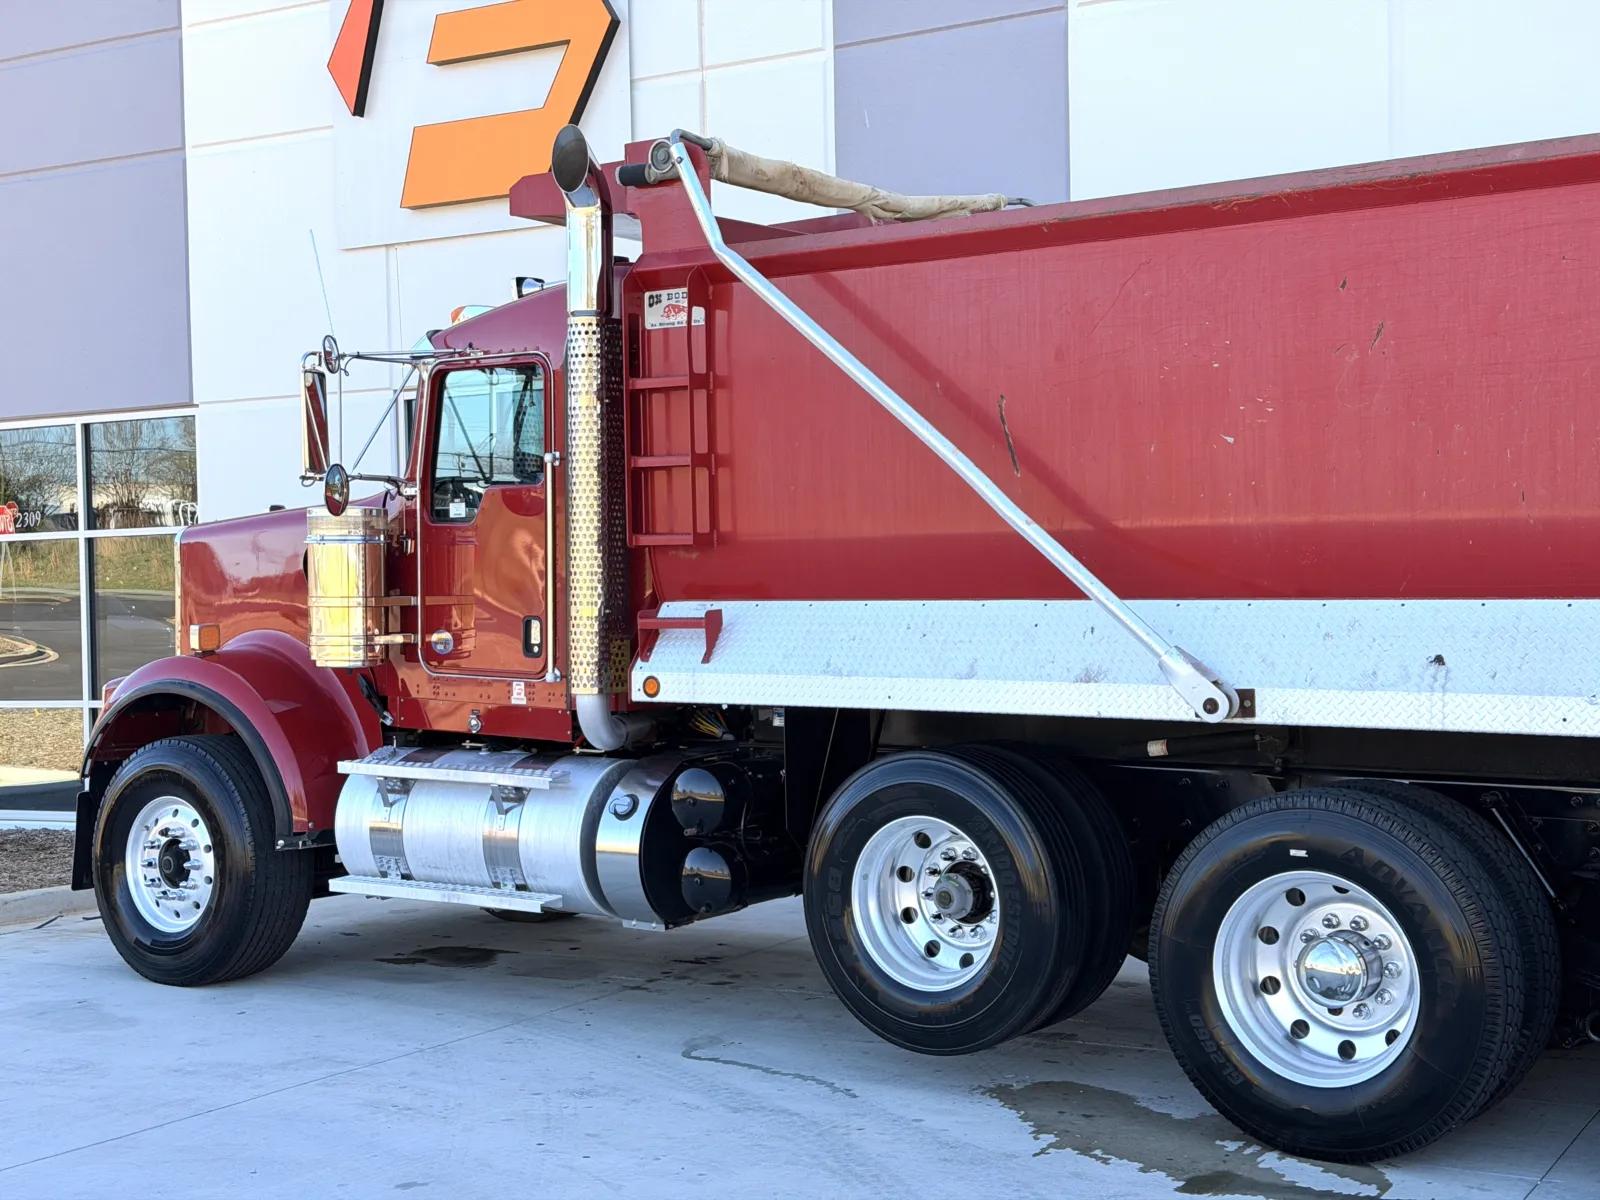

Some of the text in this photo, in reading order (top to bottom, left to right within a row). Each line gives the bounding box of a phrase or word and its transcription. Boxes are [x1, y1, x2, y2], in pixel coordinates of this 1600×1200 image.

[648, 291, 688, 308] OX BOD
[15, 511, 41, 528] 2309
